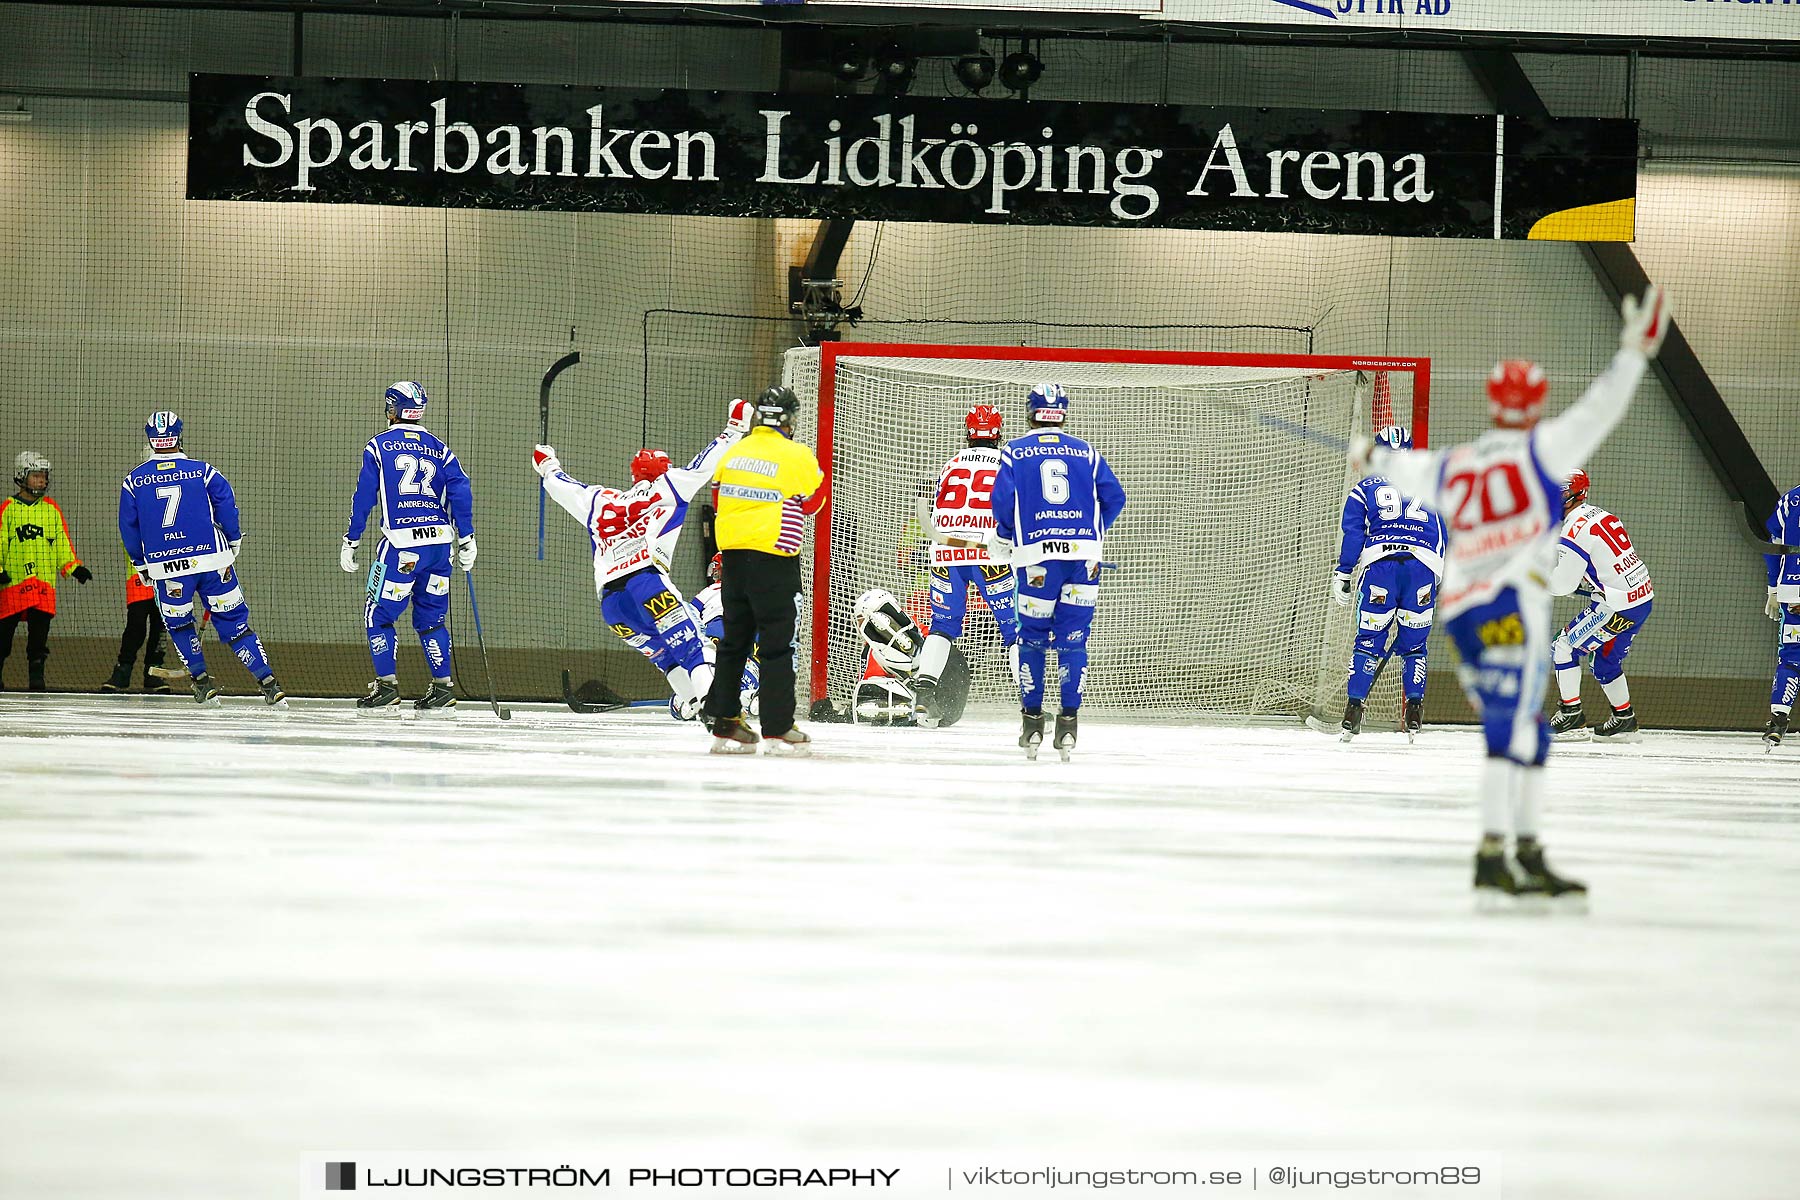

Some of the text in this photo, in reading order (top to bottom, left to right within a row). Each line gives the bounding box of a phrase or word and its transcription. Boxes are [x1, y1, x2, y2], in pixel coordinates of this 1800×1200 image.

[243, 91, 1434, 219] Sparbanken Lidköping Arena
[1012, 445, 1089, 460] Götenehus
[727, 456, 779, 478] BERGMAN
[134, 469, 203, 488] Götenehus
[394, 454, 438, 498] 22
[1039, 458, 1071, 505] 6
[1447, 462, 1531, 531] 20
[156, 485, 182, 528] 7
[395, 515, 439, 525] TOVEKS
[1035, 510, 1082, 521] KARLSSON
[164, 532, 186, 541] FALL
[412, 526, 437, 540] MVB
[1028, 527, 1093, 540] TOVEKS BIL
[1590, 514, 1632, 557] 16
[148, 543, 211, 559] TOVEKS BIL
[937, 549, 990, 561] CRAMO
[1042, 541, 1070, 554] MVB
[163, 559, 190, 573] MVB
[643, 591, 677, 616] YVS
[1610, 613, 1635, 631] YVS
